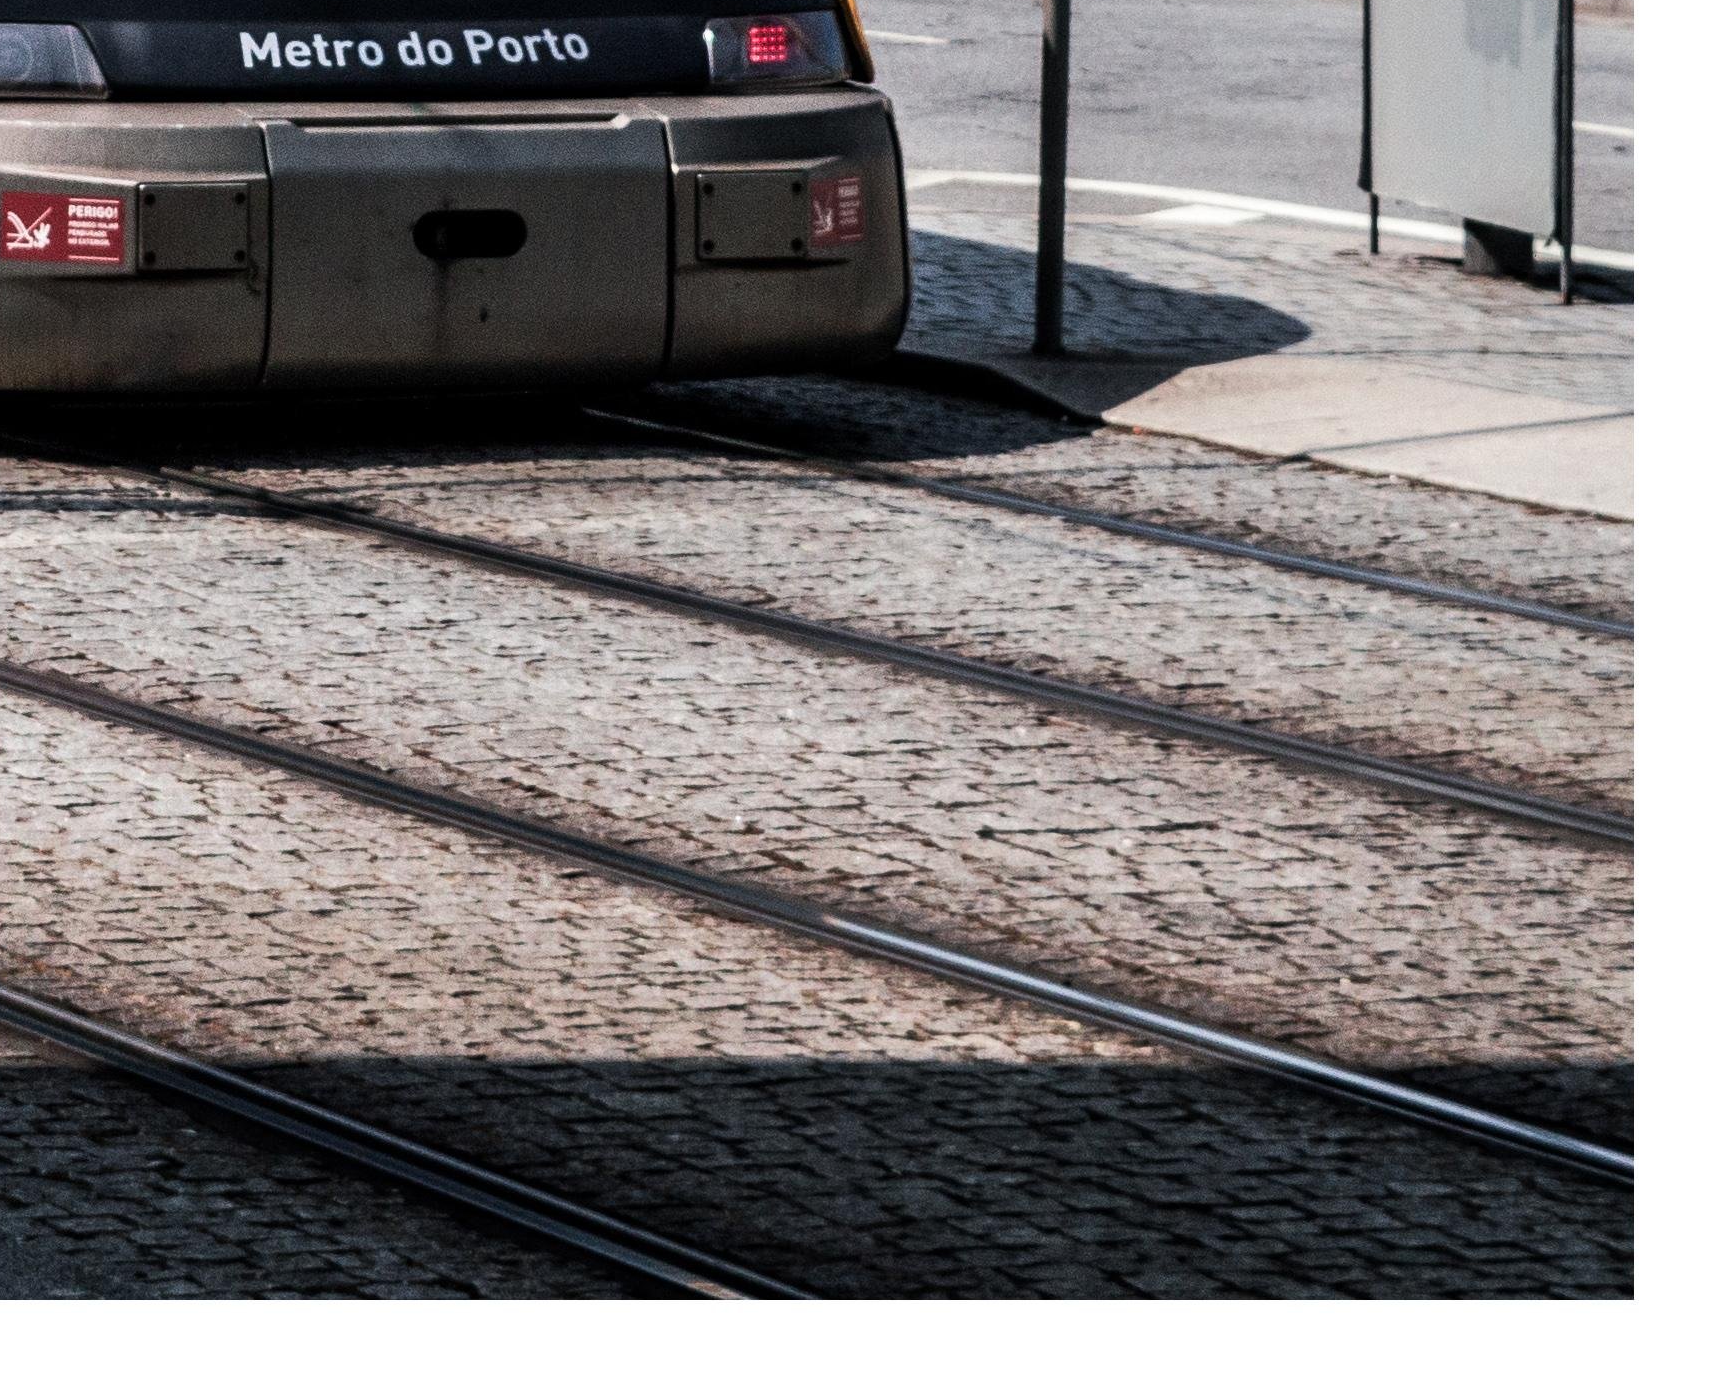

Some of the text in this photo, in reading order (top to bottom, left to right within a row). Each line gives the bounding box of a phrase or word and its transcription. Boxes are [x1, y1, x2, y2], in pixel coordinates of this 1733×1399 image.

[241, 30, 589, 68] Metro do Porto
